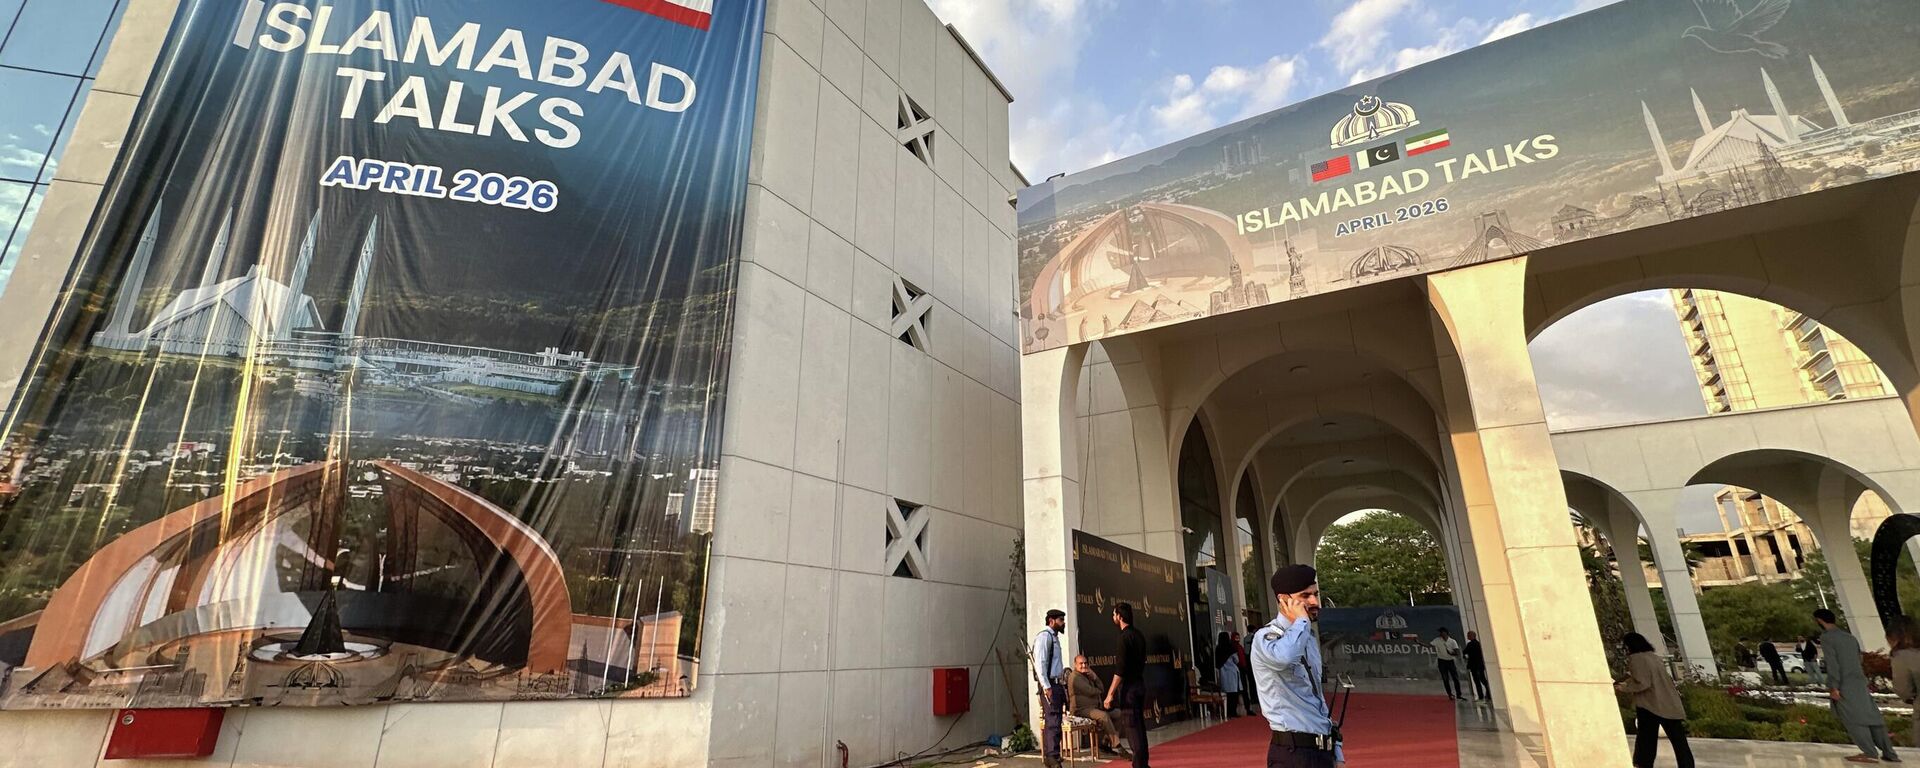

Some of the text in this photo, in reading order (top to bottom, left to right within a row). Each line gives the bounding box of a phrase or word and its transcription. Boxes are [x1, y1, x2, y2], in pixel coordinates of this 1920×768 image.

[233, 0, 697, 112] ISLAMABAD
[336, 67, 585, 149] TALKS
[321, 156, 558, 212] APRIL 2026
[1236, 134, 1559, 235] ISLAMABAD TALKS
[1335, 198, 1449, 238] APRIL 2026
[1342, 643, 1436, 655] ISLAMABAD TAL
